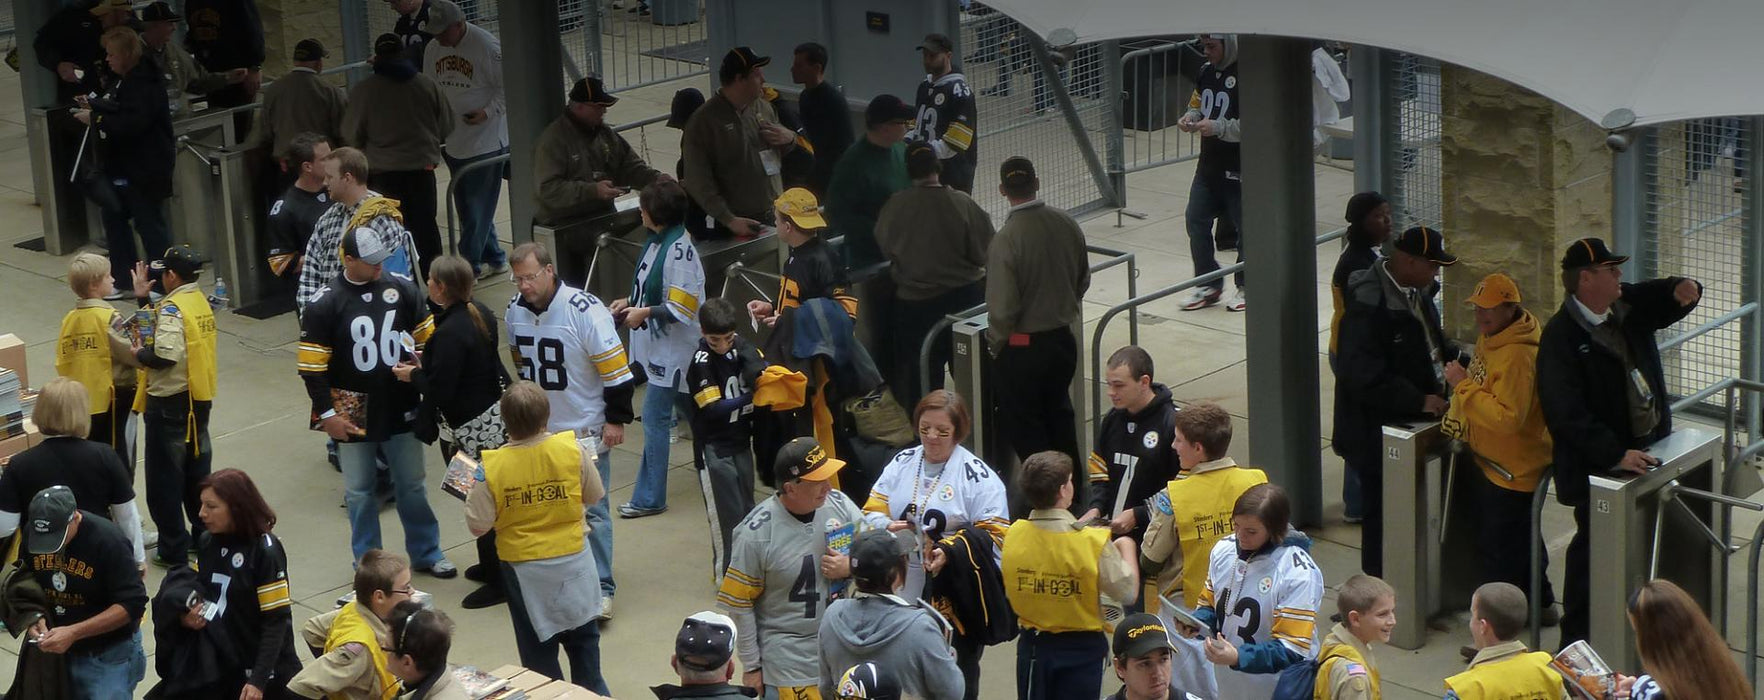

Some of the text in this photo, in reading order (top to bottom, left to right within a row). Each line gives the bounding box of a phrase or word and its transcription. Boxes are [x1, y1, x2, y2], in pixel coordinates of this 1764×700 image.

[435, 55, 474, 80] PITTSBURGH
[952, 82, 971, 98] 43
[674, 242, 694, 262] 56
[350, 309, 403, 372] 86
[514, 335, 569, 391] 58
[694, 350, 710, 364] 92
[964, 459, 990, 484] 43
[1111, 452, 1140, 521] 7
[828, 535, 852, 549] FREE
[211, 572, 232, 619] 7
